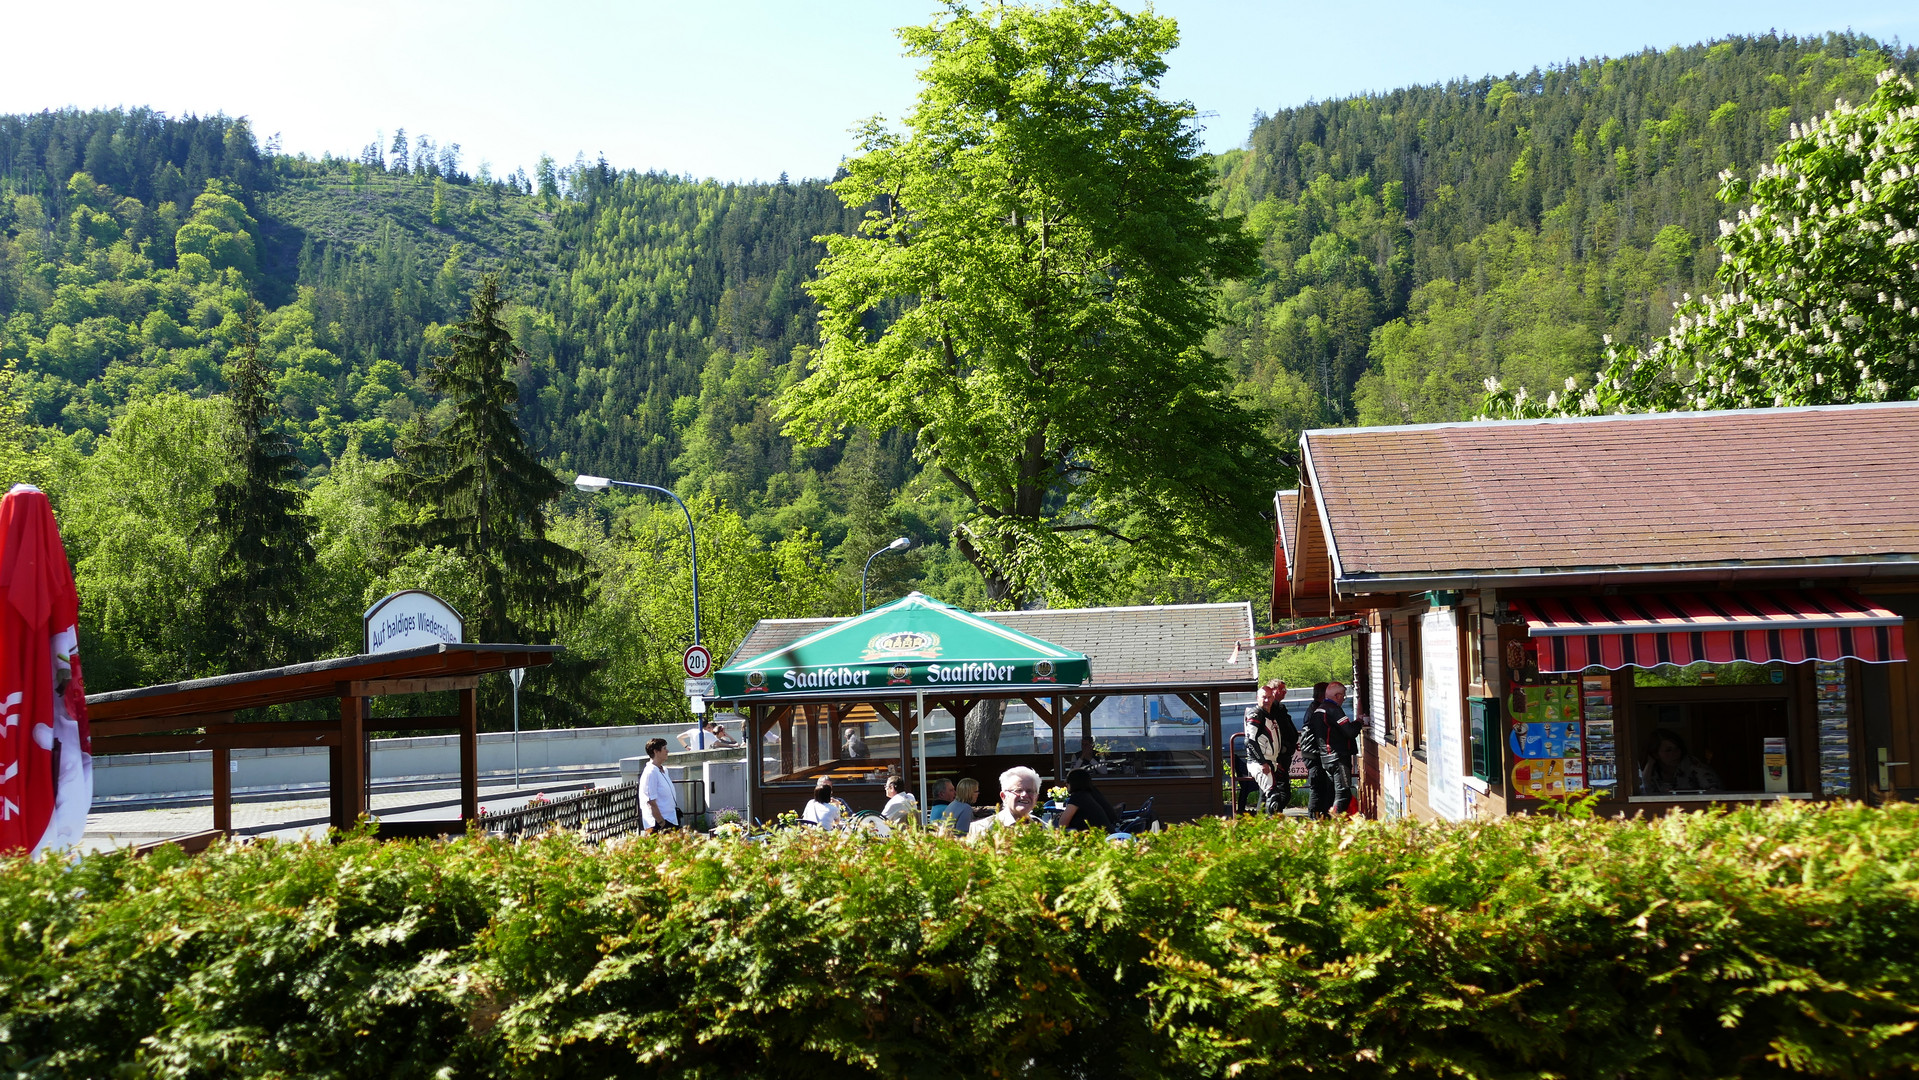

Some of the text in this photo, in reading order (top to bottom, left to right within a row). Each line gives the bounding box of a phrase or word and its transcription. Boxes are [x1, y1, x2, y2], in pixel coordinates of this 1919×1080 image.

[372, 622, 386, 652] Auf
[387, 612, 415, 640] baldiges
[783, 662, 1016, 689] Saalfelder Saalfelder
